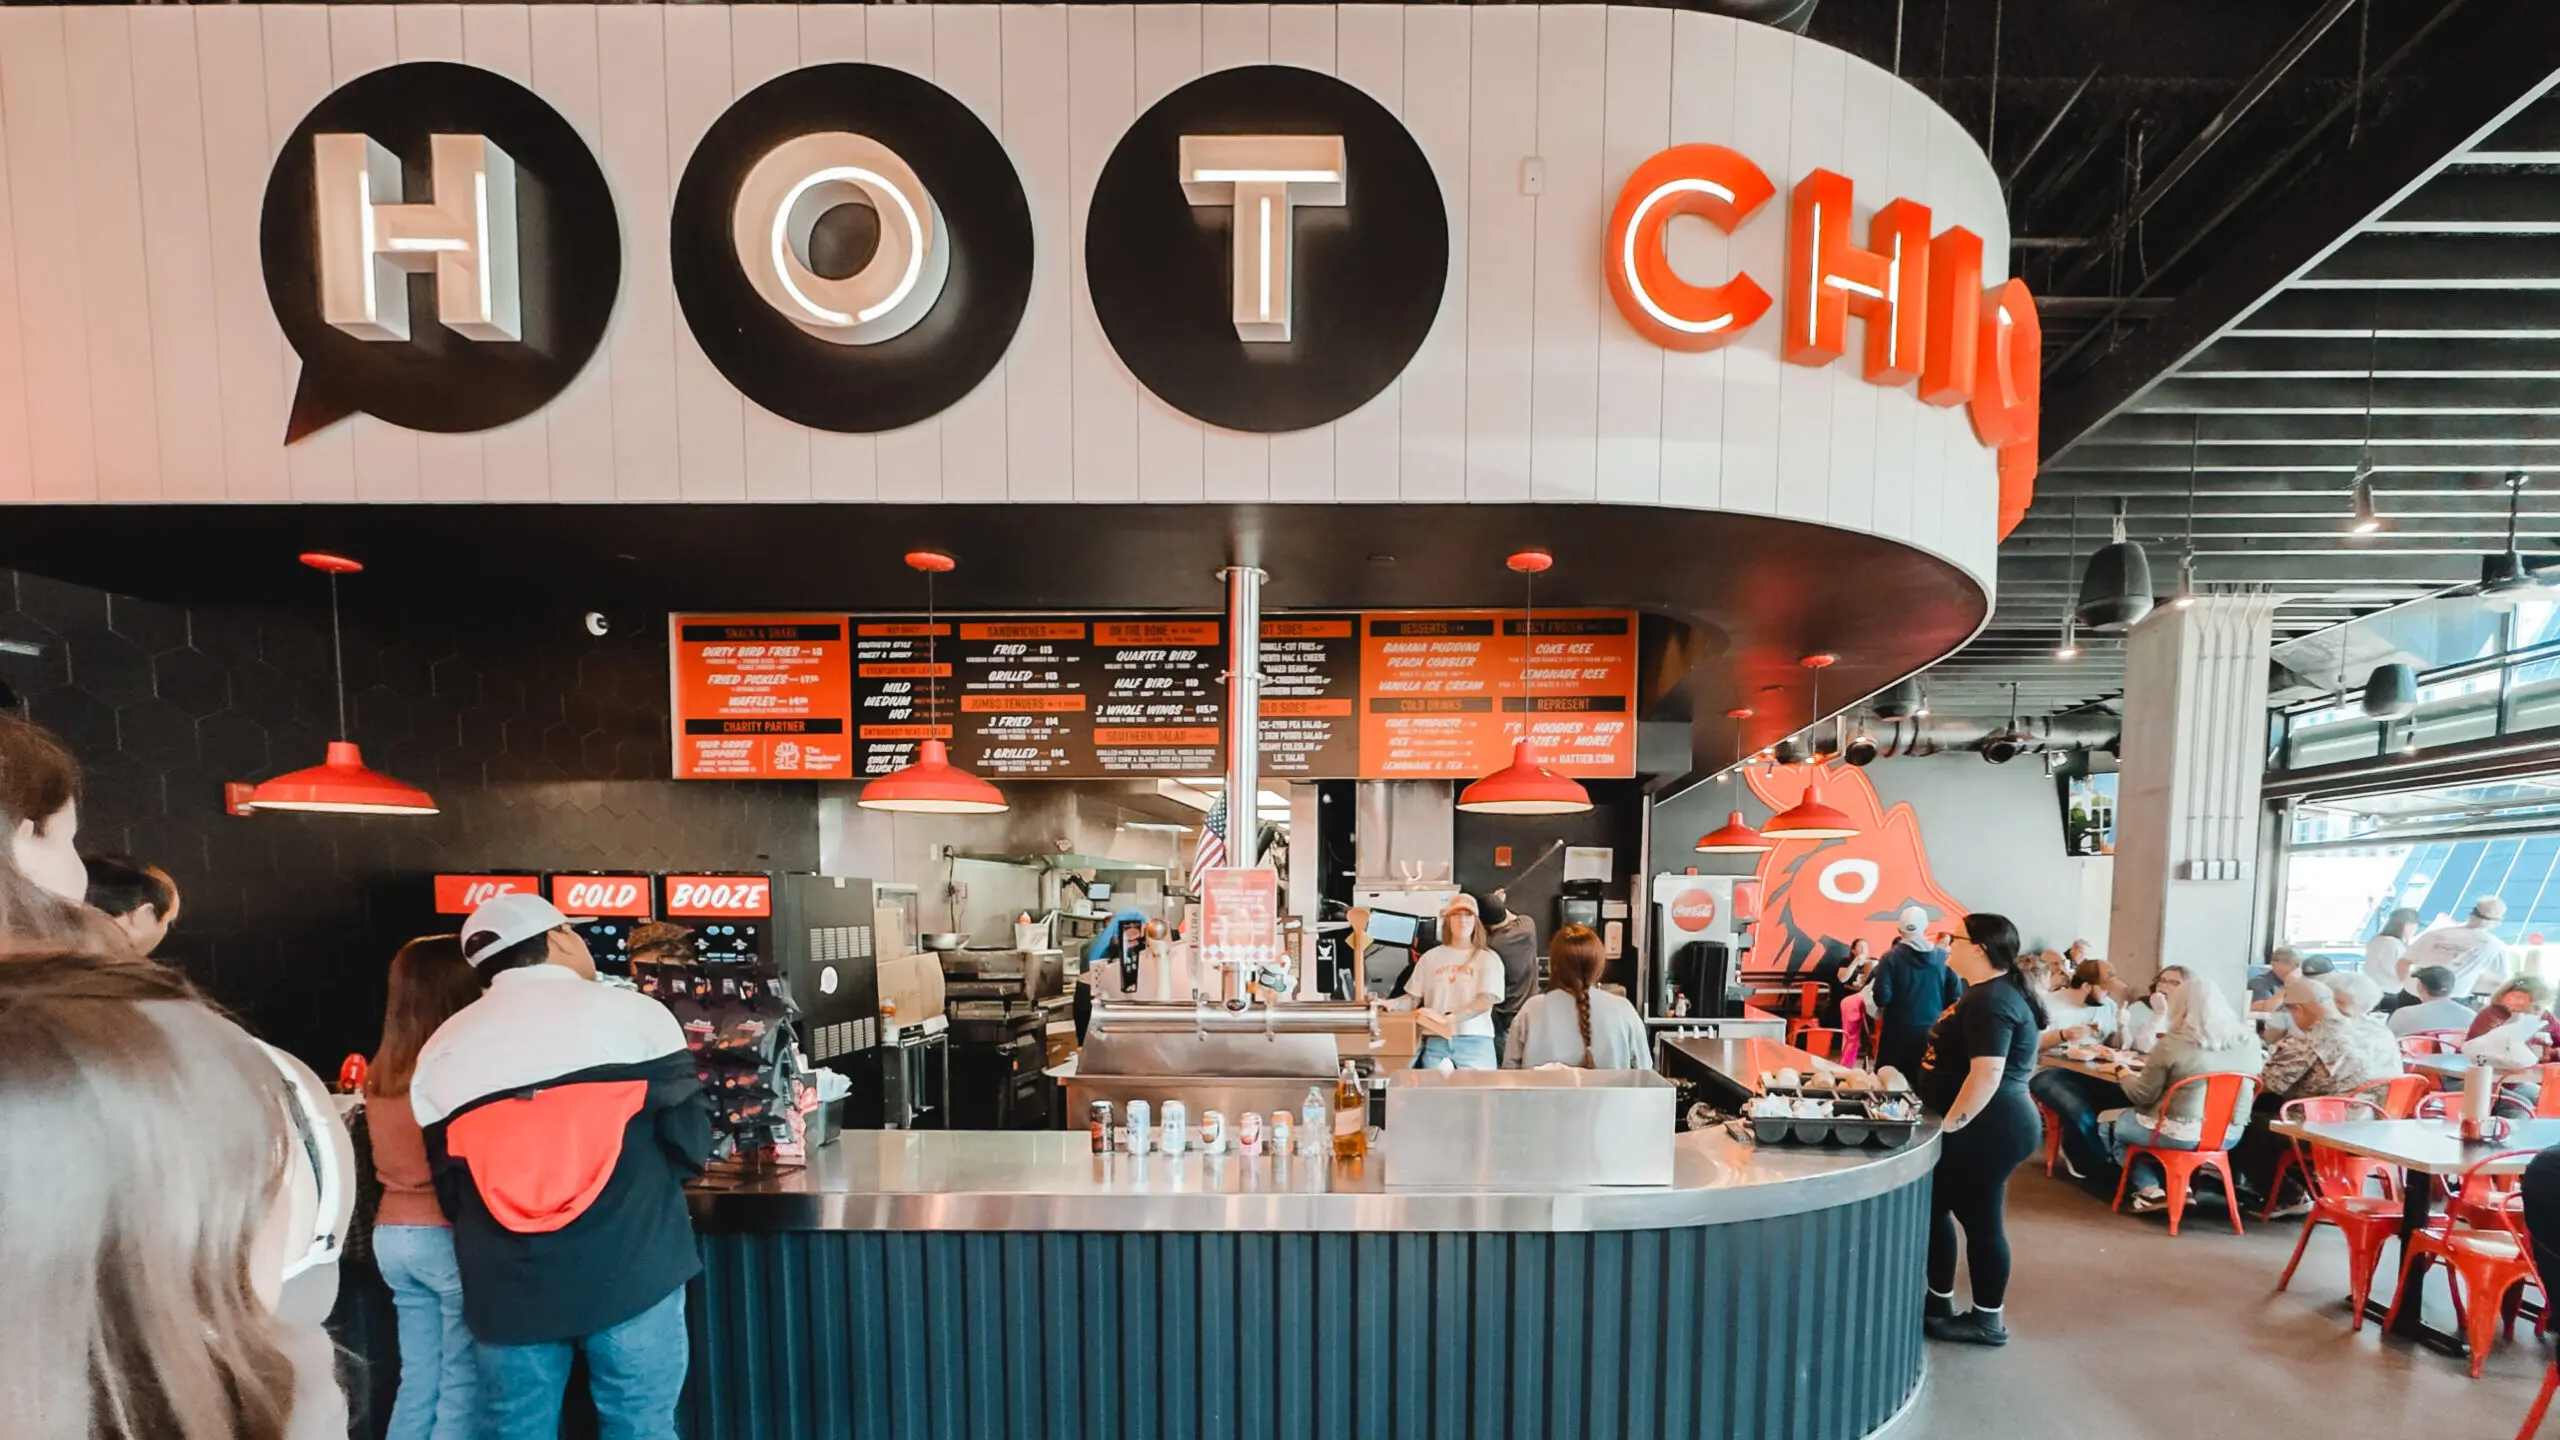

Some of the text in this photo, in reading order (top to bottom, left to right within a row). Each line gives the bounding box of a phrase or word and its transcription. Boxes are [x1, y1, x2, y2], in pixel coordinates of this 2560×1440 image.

[314, 132, 1348, 345] HOT
[993, 644, 1027, 655] FRIED
[1116, 650, 1197, 661] QUARTER BIRD
[988, 671, 1033, 682] GRILLED
[882, 682, 911, 693] MILD
[1115, 678, 1143, 688] HALF
[1144, 678, 1173, 688] BIRD
[864, 696, 912, 707] MEDIUM
[1537, 698, 1589, 710] REPRESENT
[888, 708, 912, 719] HOT
[1095, 705, 1103, 715] 3
[1106, 705, 1144, 715] WHOLE
[1147, 705, 1183, 715] WINGS
[724, 721, 805, 732] CHARITY PARTNER
[988, 716, 997, 727] 3
[998, 716, 1033, 727] FRIED
[1532, 722, 1584, 733] HOODIES
[1593, 722, 1625, 733] HATS
[1106, 731, 1154, 742] SOUTHERN
[1157, 730, 1187, 741] SALAD
[1574, 735, 1615, 746] MORE!
[983, 747, 991, 759] 3
[993, 747, 1038, 759] GRILLED
[567, 883, 638, 908] COLD
[671, 883, 769, 909] BOOZE
